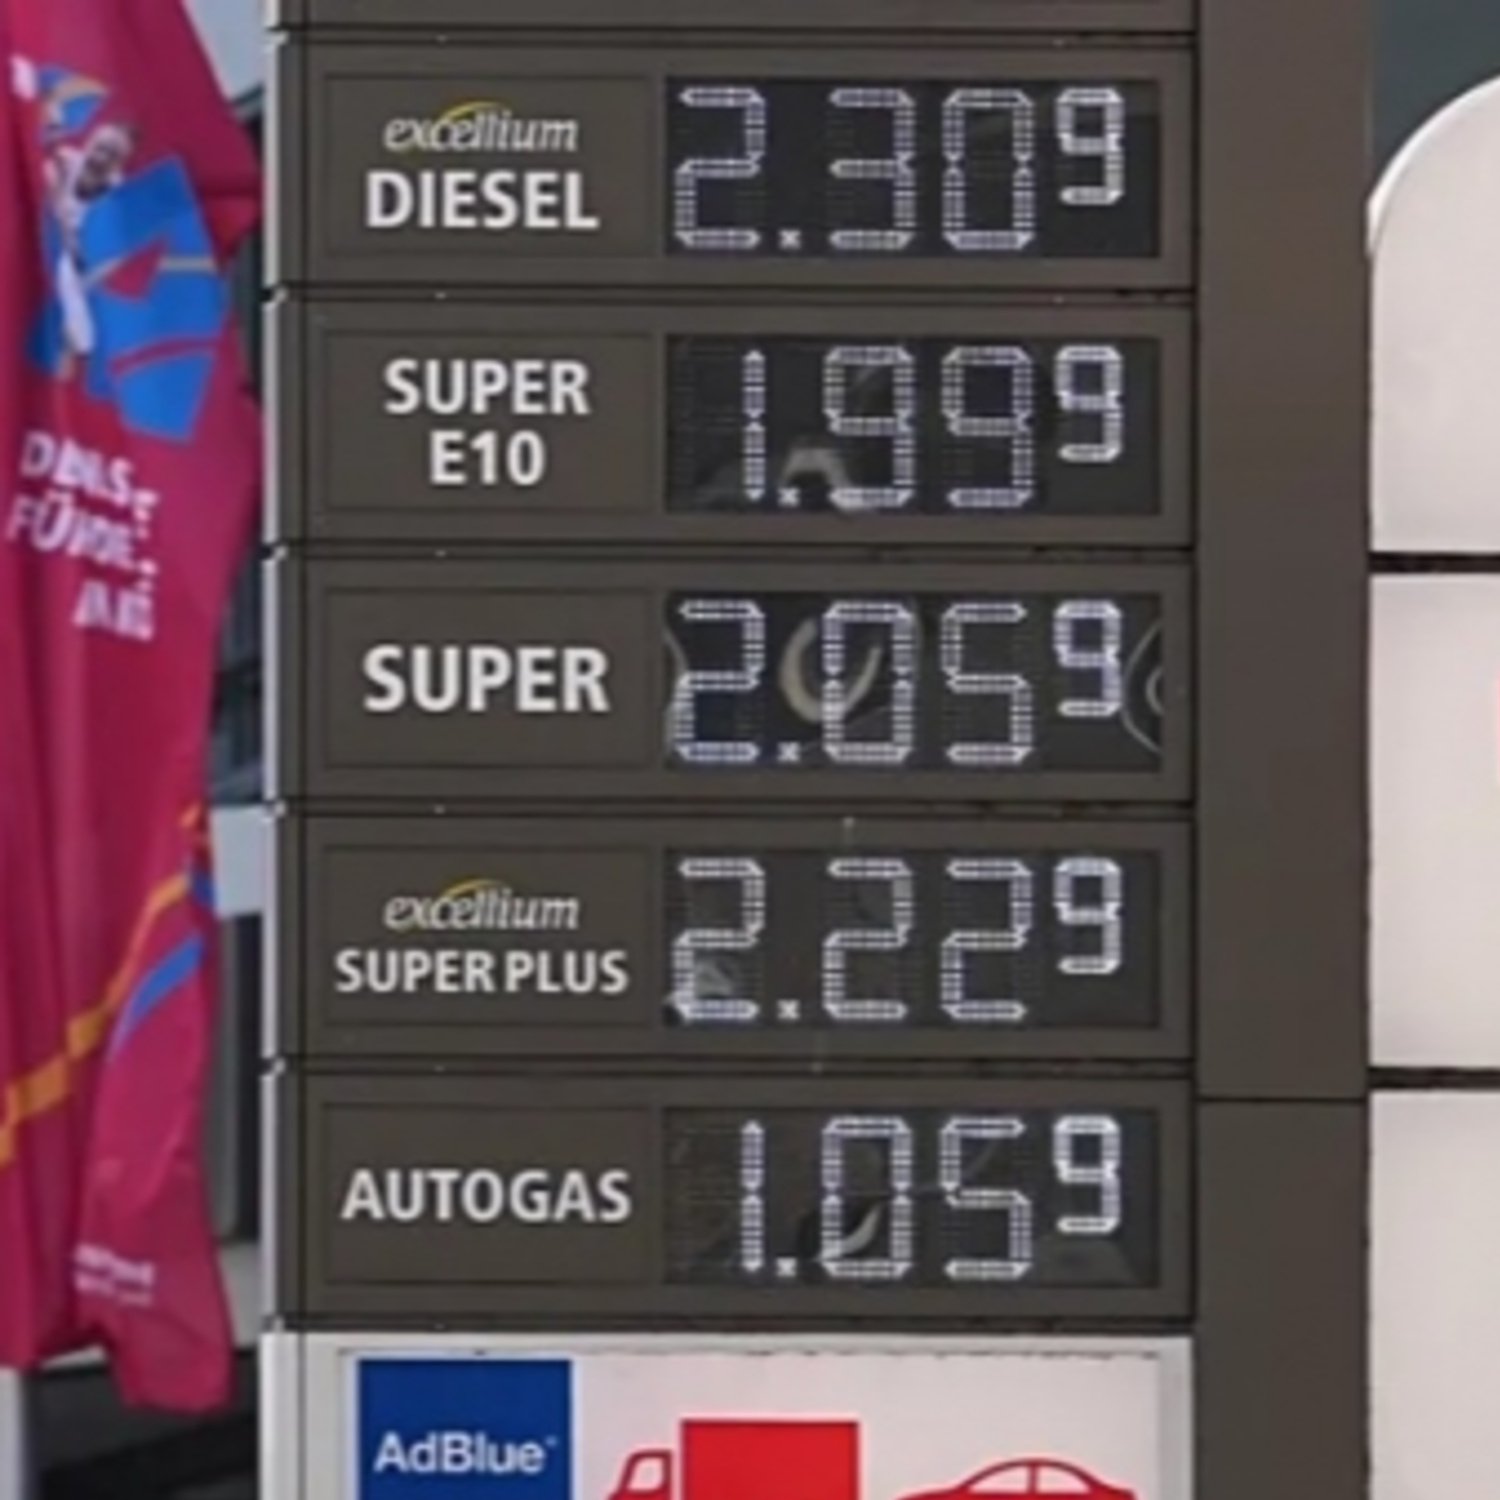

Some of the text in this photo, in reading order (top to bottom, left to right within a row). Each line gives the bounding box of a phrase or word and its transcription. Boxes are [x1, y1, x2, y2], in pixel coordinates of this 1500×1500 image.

[384, 114, 578, 153] excellium
[366, 170, 600, 229] DIESEL
[384, 358, 590, 415] SUPER
[430, 429, 545, 486] E10
[363, 644, 609, 713] SUPER
[384, 888, 579, 931] excellium
[335, 949, 628, 994] SUPER PLUS
[341, 1168, 632, 1222] AUTOGAS
